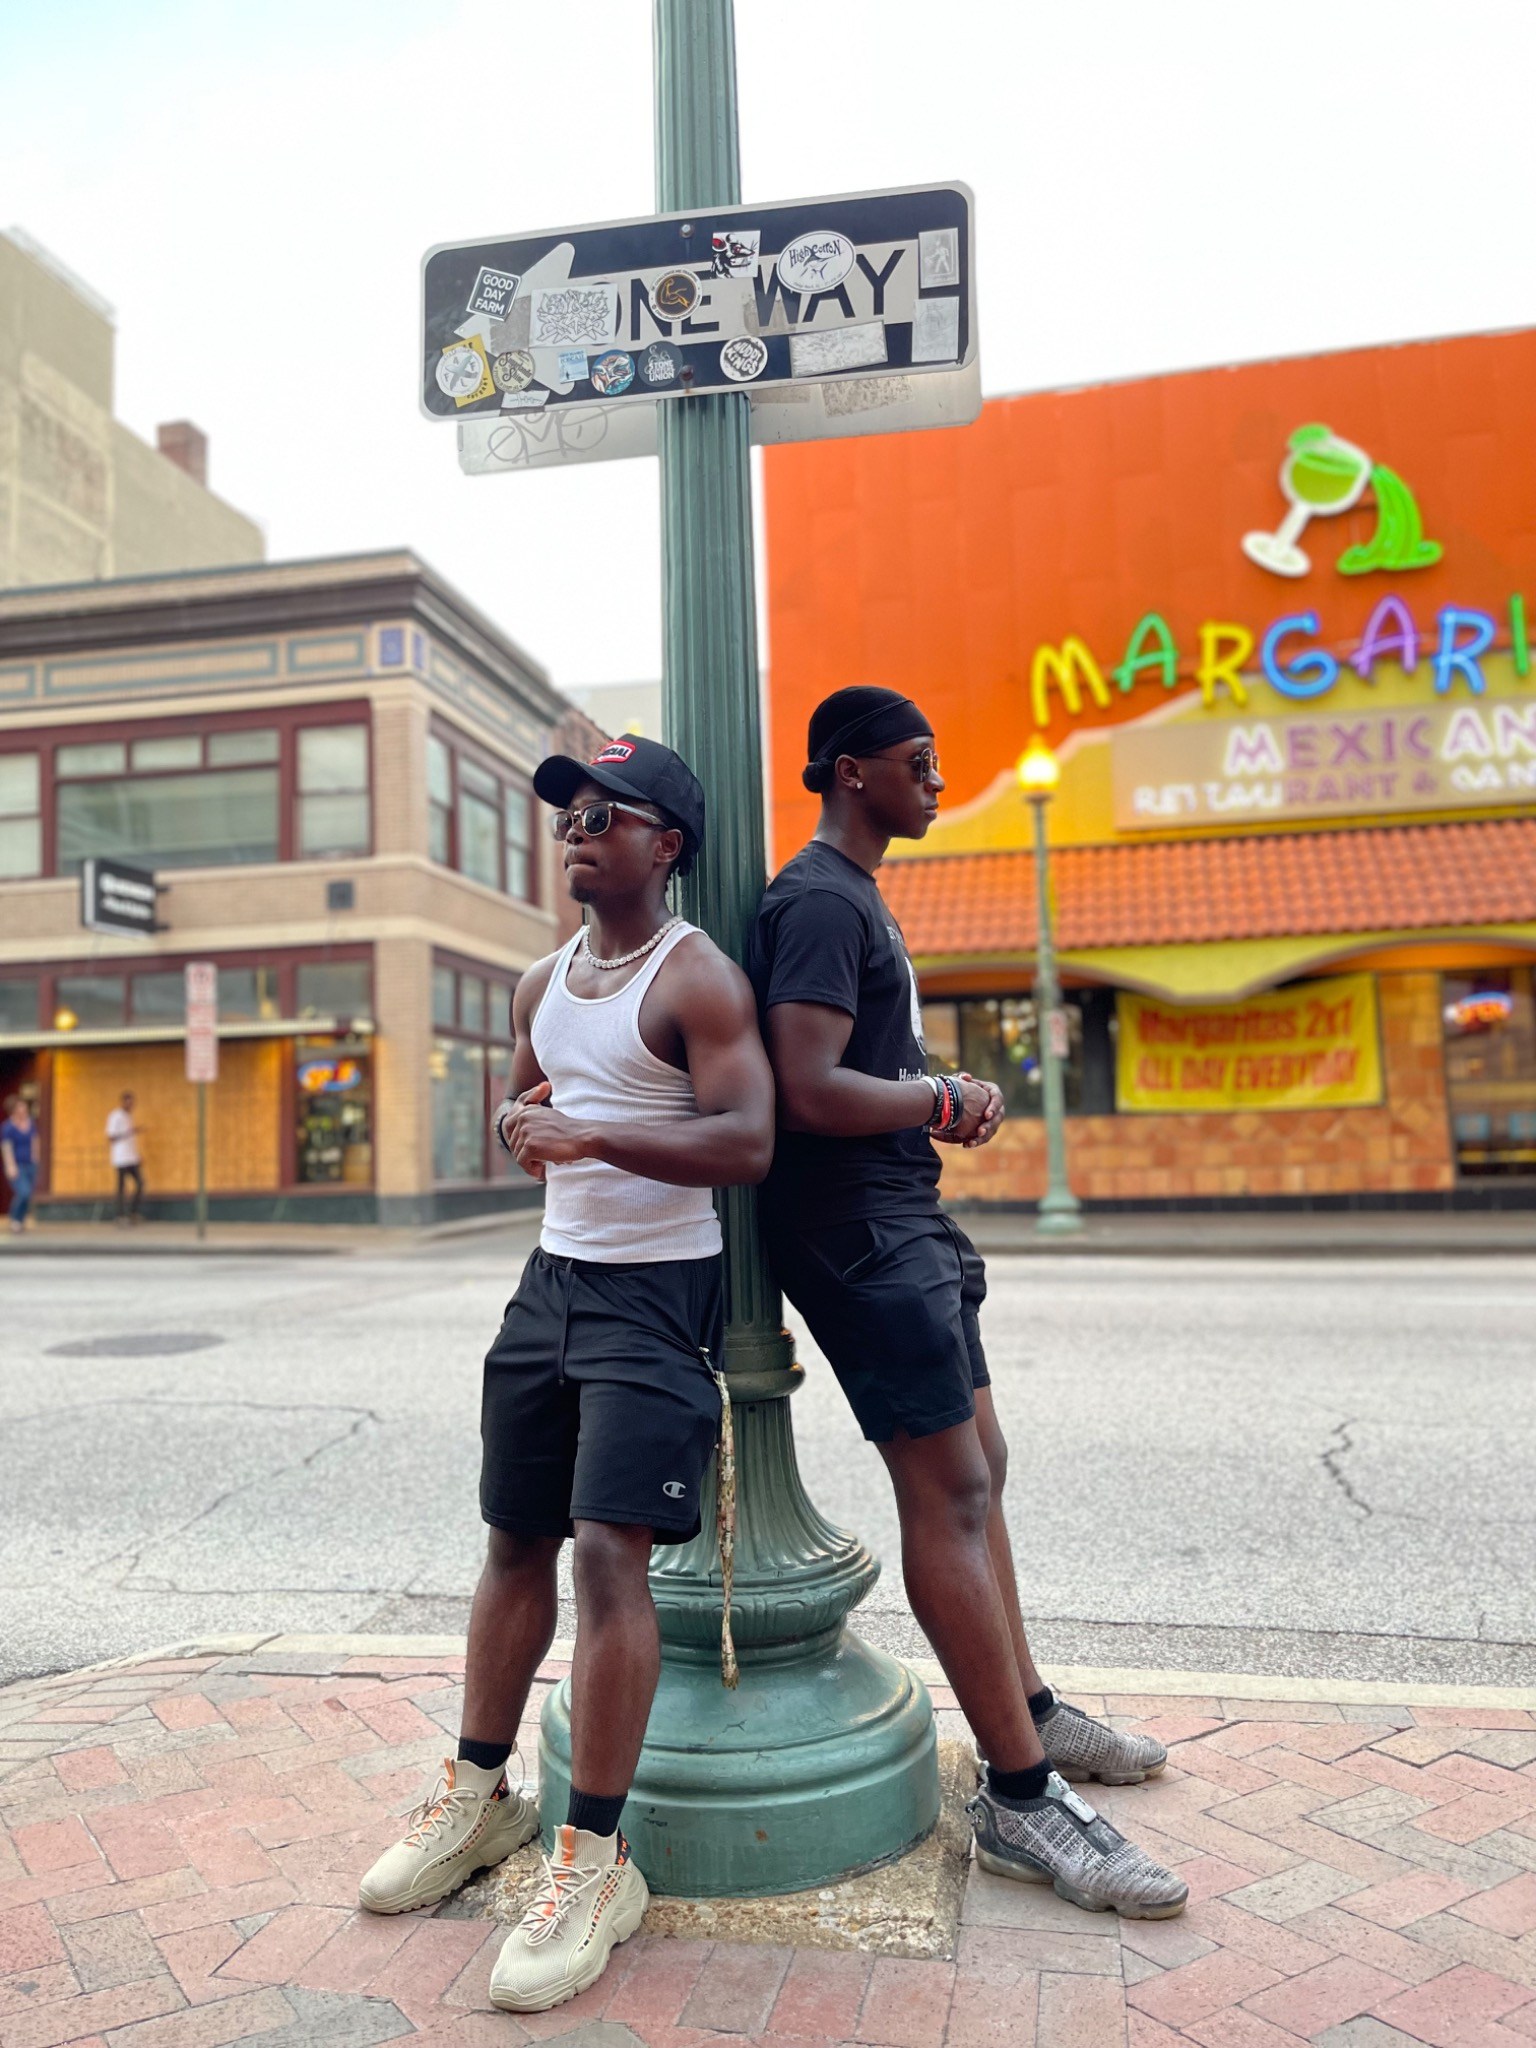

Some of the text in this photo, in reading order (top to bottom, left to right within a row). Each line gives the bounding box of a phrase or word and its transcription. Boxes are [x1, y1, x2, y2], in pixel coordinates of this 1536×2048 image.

[482, 273, 515, 291] GOOD
[752, 248, 906, 327] WAY
[482, 287, 506, 302] DAY
[474, 298, 506, 315] FARM
[649, 360, 674, 369] STONE
[726, 347, 758, 375] KINGS
[649, 371, 676, 382] UNION
[1029, 593, 1532, 728] MARGARI
[1222, 705, 1536, 778] MEXICAN
